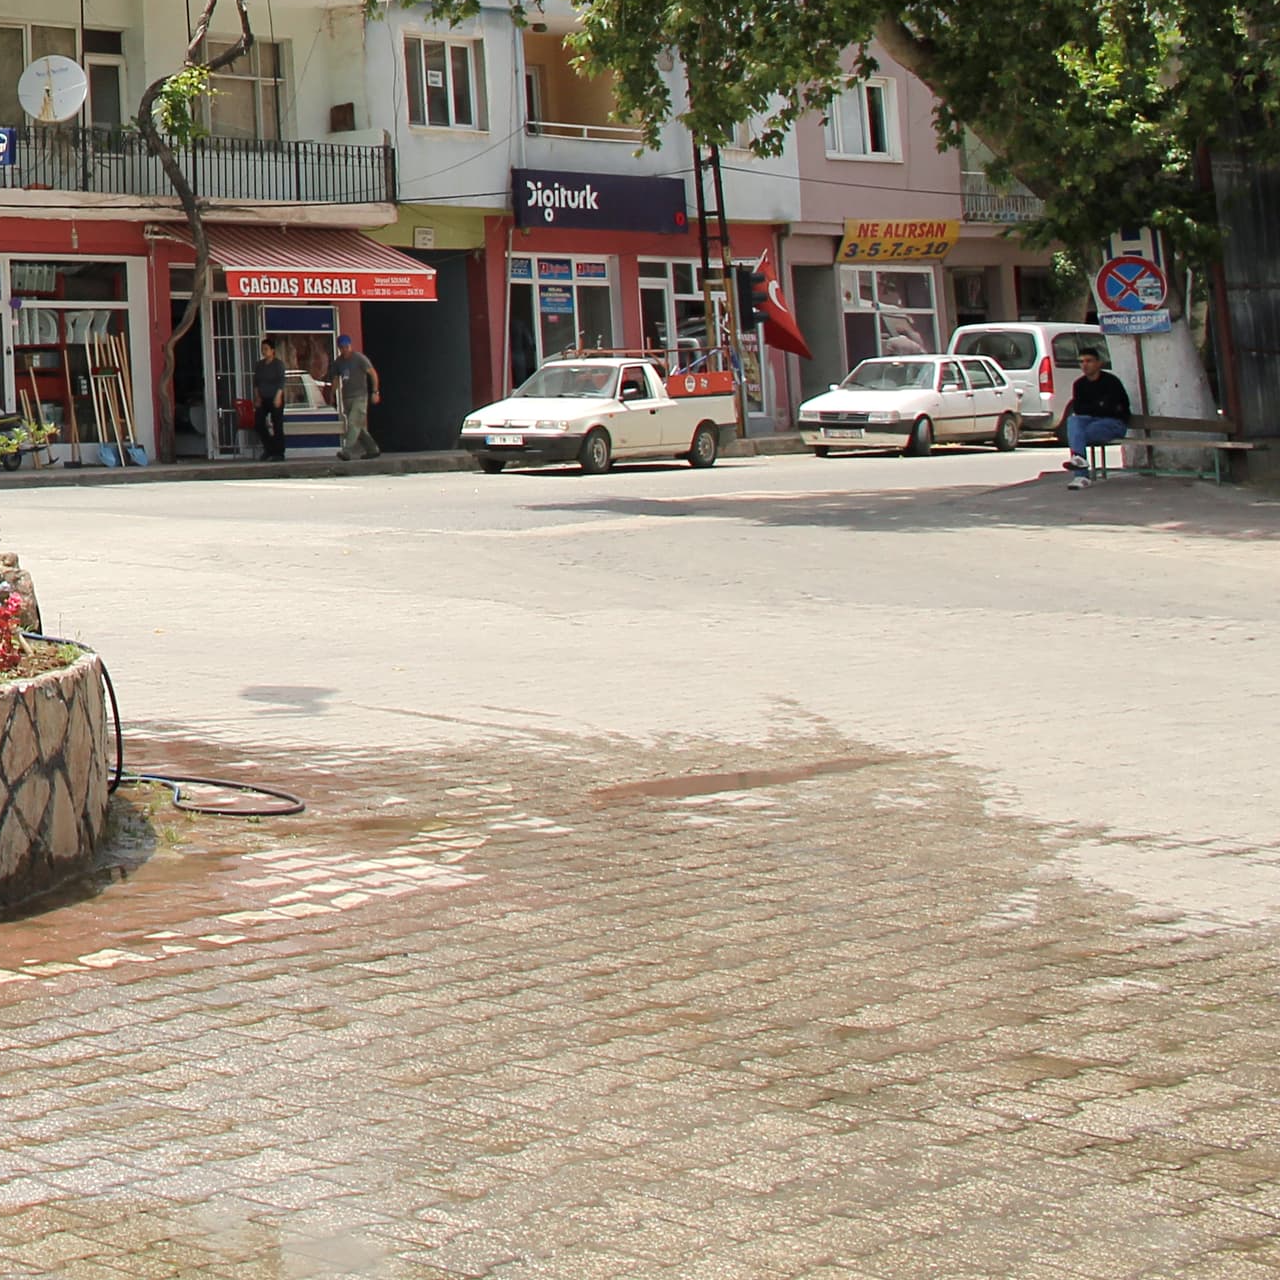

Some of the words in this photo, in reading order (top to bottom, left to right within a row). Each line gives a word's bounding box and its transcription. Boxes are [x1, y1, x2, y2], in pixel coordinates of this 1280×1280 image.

[526, 180, 599, 222] Digiturk
[858, 223, 879, 238] NE
[883, 223, 946, 238] ALIRSAN
[239, 275, 299, 296] ÇAĞDAŞ
[304, 278, 357, 295] KASABI
